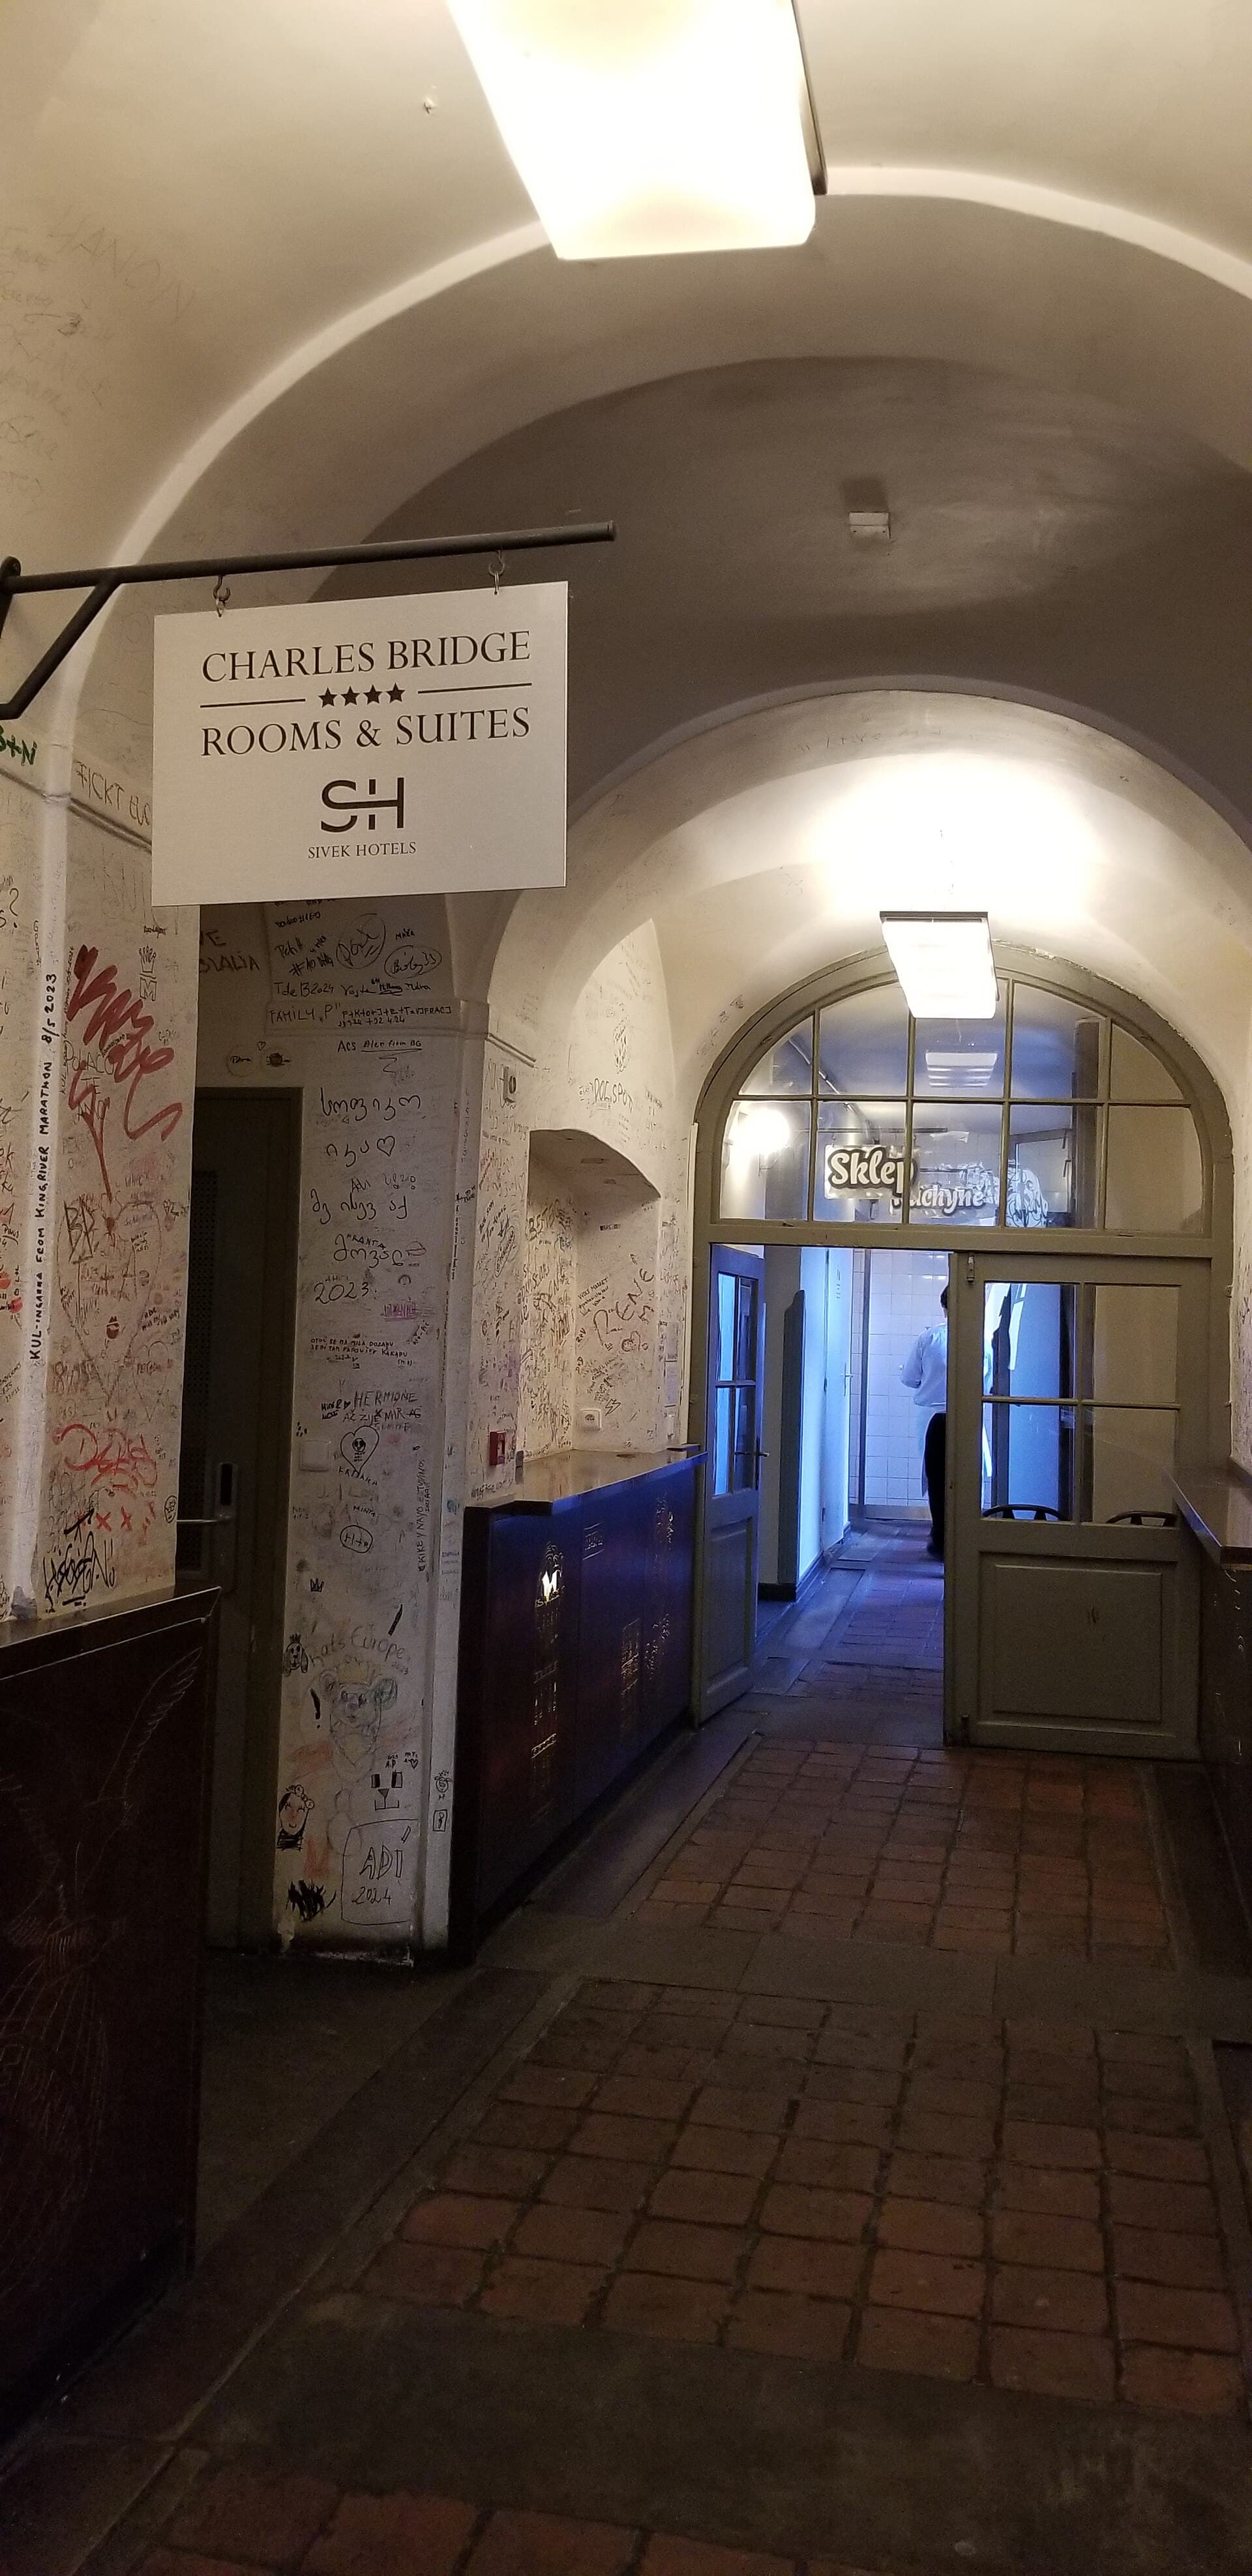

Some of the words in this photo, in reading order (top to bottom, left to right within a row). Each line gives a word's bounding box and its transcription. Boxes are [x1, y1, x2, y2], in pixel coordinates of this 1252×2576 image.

[202, 642, 374, 683] CHARLES
[387, 630, 531, 670] BRIDGE
[201, 719, 342, 756] ROOMS
[355, 720, 382, 747] &
[395, 707, 529, 747] SUITES
[320, 777, 405, 833] SH
[308, 844, 351, 859] SIVEK
[355, 841, 417, 857] HOTELS
[44, 973, 57, 1013] 2023
[38, 1062, 53, 1135] MARATHON
[35, 1227, 45, 1264] FROM
